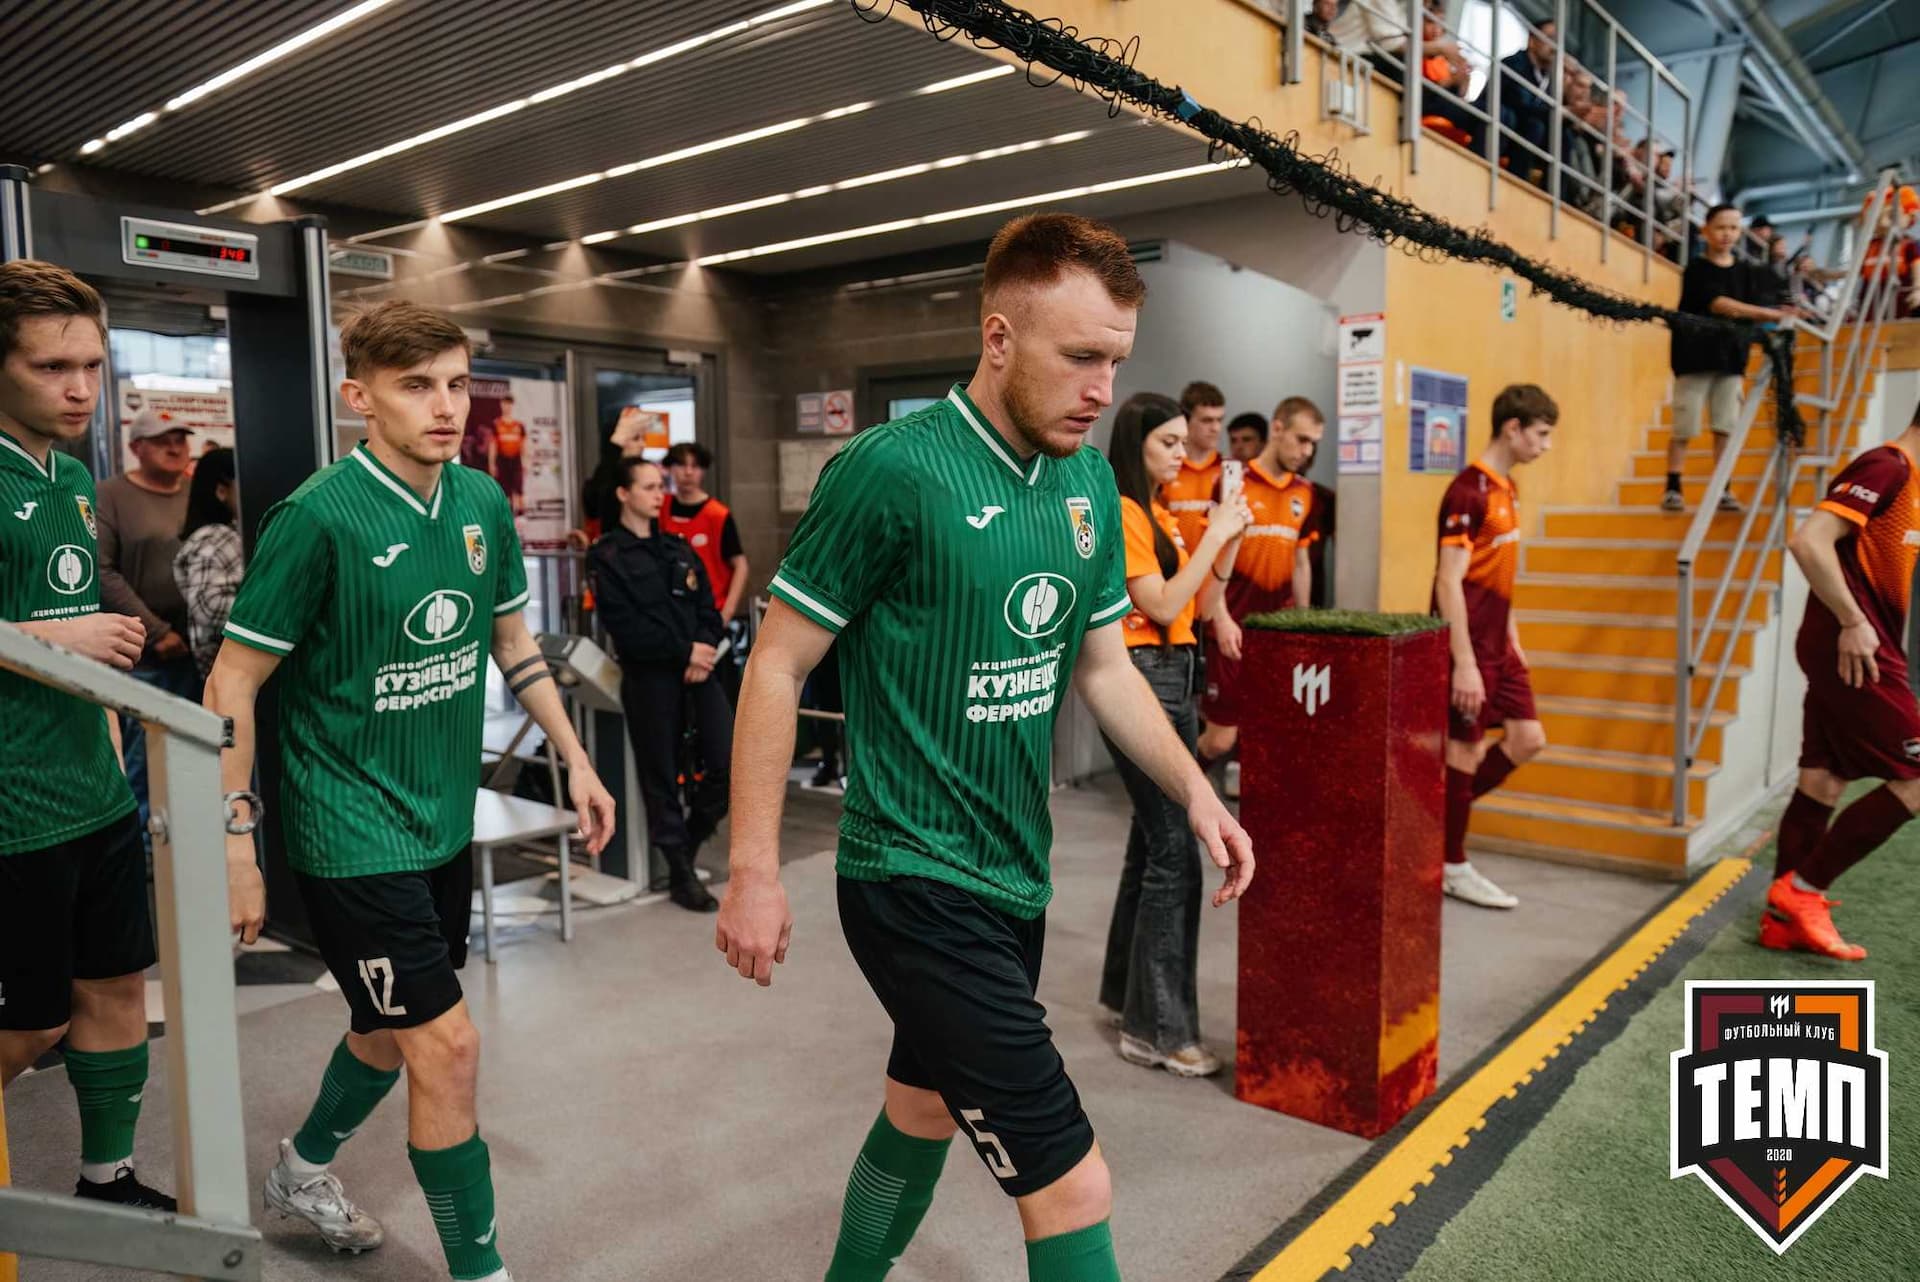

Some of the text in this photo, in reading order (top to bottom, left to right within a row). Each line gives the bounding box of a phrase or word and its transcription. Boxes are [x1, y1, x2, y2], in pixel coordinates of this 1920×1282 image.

[374, 649, 478, 697] КУЗНЕЦКИЕ
[967, 661, 1059, 698] КУЗНЕЦК
[357, 957, 408, 1015] 12
[960, 1108, 1018, 1178] 5
